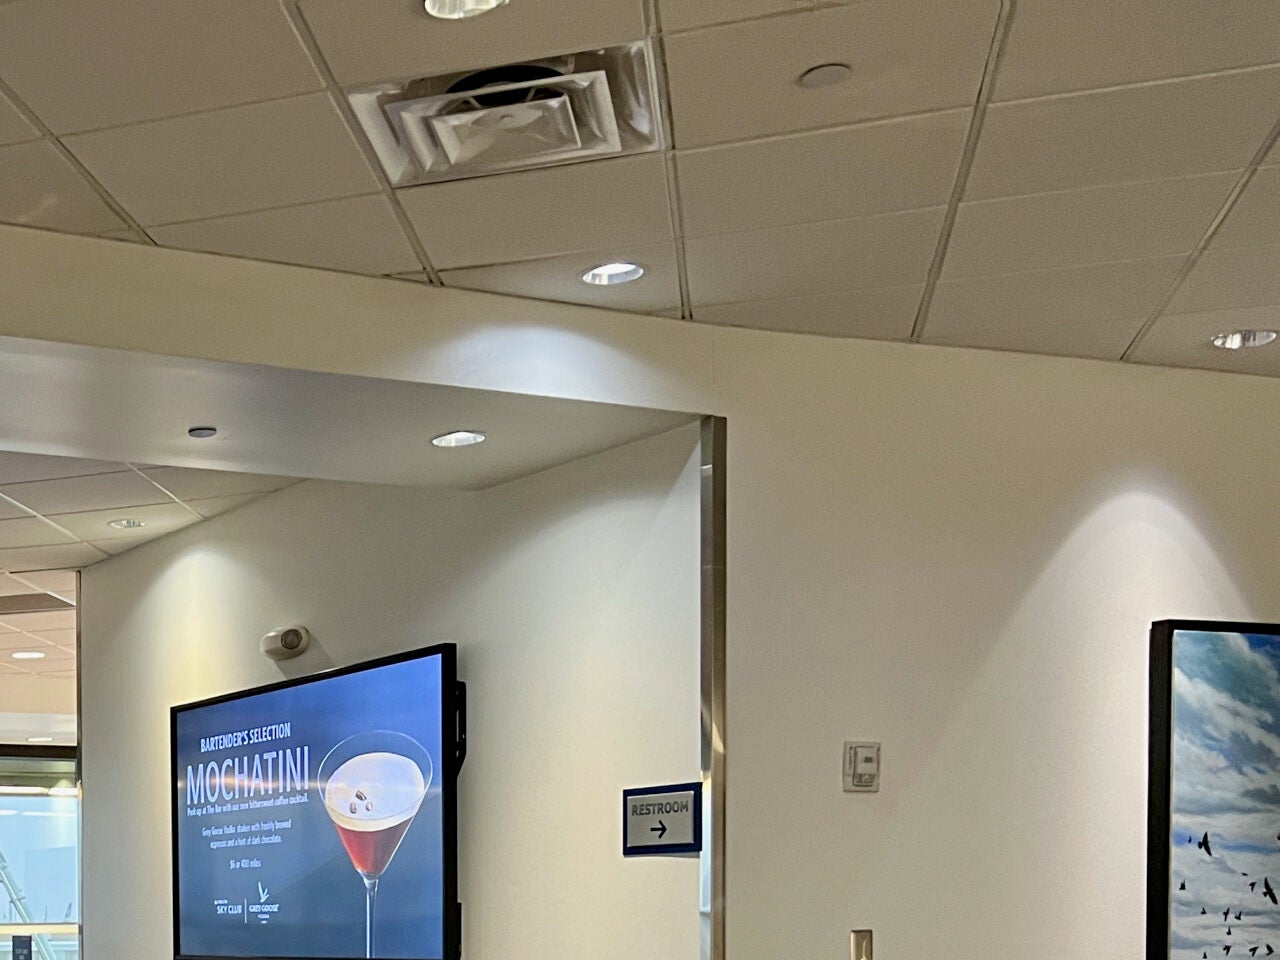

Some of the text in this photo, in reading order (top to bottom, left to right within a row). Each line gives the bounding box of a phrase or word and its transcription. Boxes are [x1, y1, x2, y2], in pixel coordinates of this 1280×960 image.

[200, 722, 291, 753] BARTENDER'S SELECTION
[186, 746, 309, 805] MOCHATINI
[631, 801, 689, 816] RESTROOM
[216, 904, 242, 914] SKY CLUB
